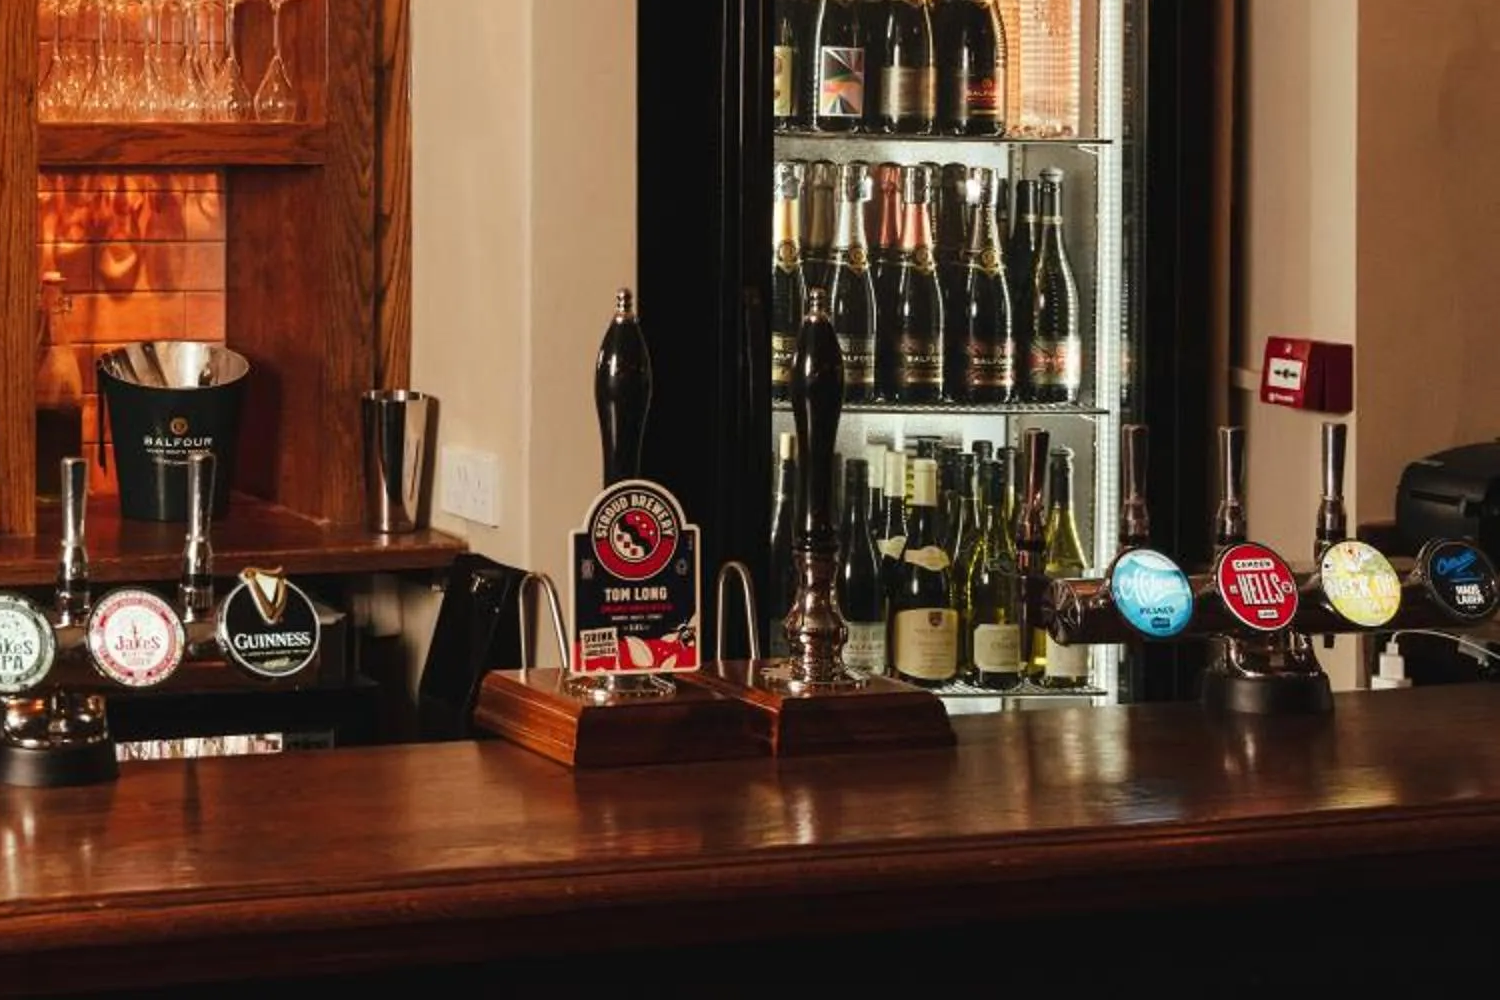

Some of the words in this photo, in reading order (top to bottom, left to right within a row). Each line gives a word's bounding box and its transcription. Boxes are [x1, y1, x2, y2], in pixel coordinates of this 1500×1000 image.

[144, 436, 212, 447] BALFOUR
[596, 497, 628, 538] STROUD
[631, 493, 675, 536] BREWERY
[1234, 560, 1273, 569] CAMDEN
[604, 587, 631, 602] TOM
[634, 586, 668, 601] LONG
[1236, 573, 1285, 605] HELLS
[234, 631, 312, 650] GUINNESS
